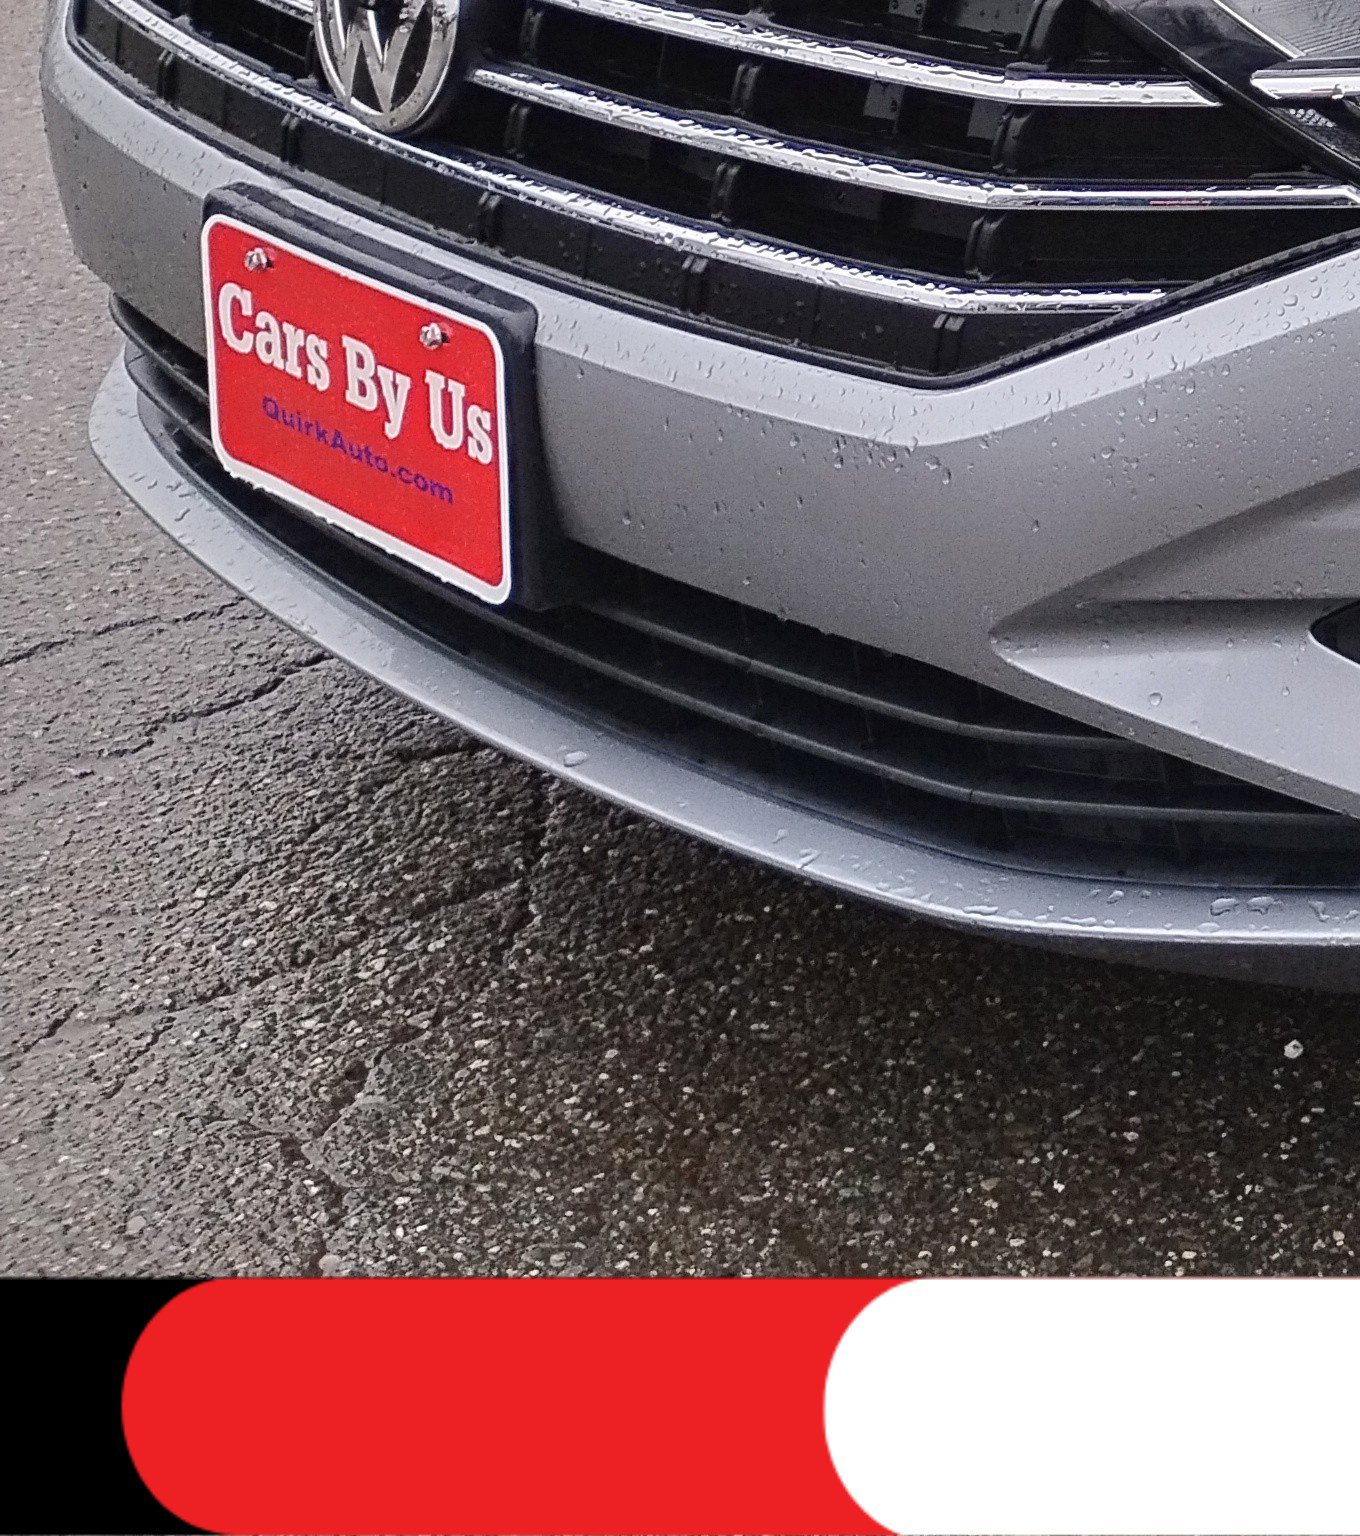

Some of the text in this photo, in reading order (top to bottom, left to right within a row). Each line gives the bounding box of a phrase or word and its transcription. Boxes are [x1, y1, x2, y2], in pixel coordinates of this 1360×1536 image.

[218, 282, 494, 465] Cars By Us
[262, 395, 454, 504] QuirkAuto.com
